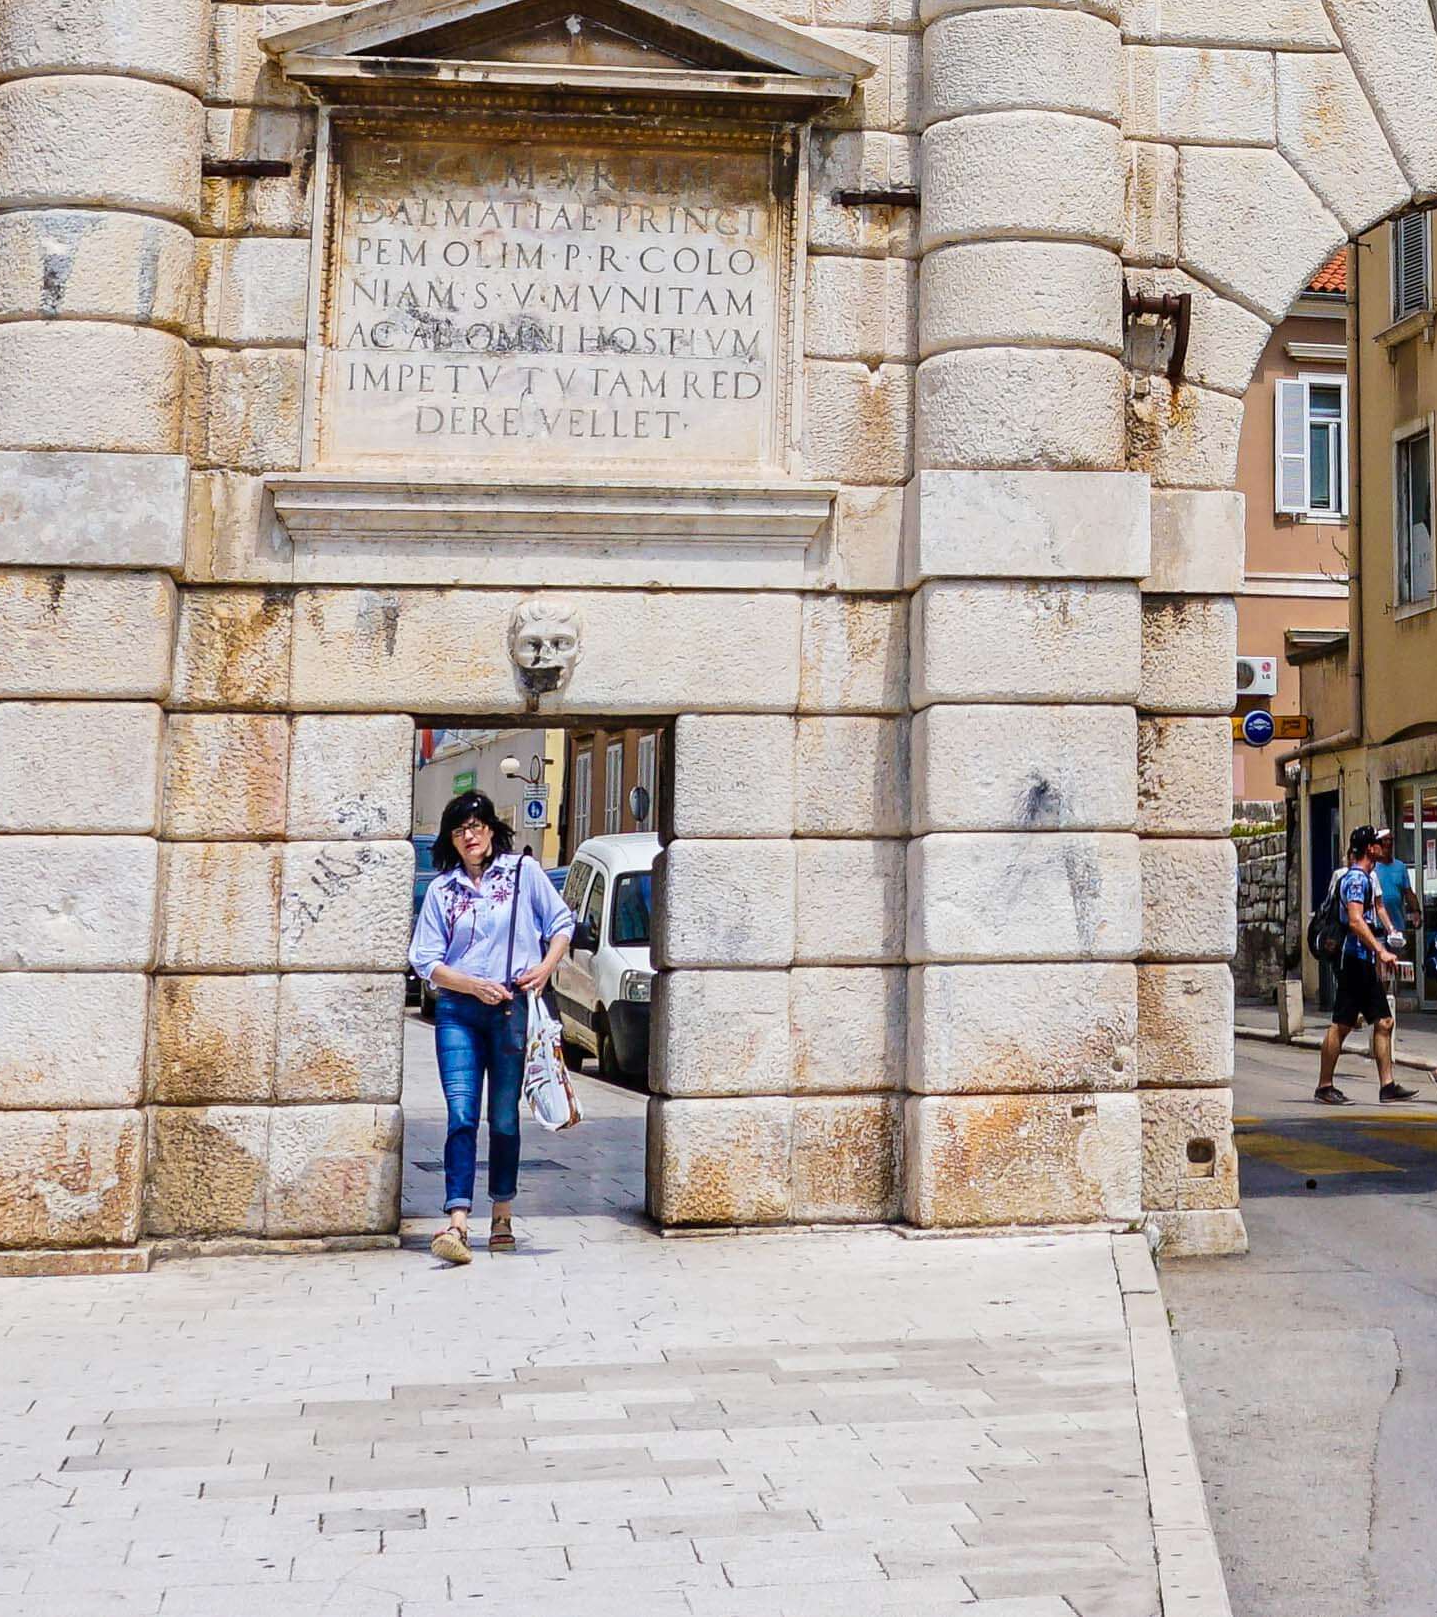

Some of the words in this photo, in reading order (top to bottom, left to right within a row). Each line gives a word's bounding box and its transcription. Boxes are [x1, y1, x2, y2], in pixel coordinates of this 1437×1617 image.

[616, 205, 756, 236] PRINCI
[356, 238, 427, 267] PEM
[639, 247, 755, 276] COLO
[551, 284, 754, 316] MVNITAM
[579, 326, 761, 358] HOSTIVM
[348, 363, 501, 393] IMPETV
[683, 371, 762, 401] RED
[416, 405, 519, 437] DERE
